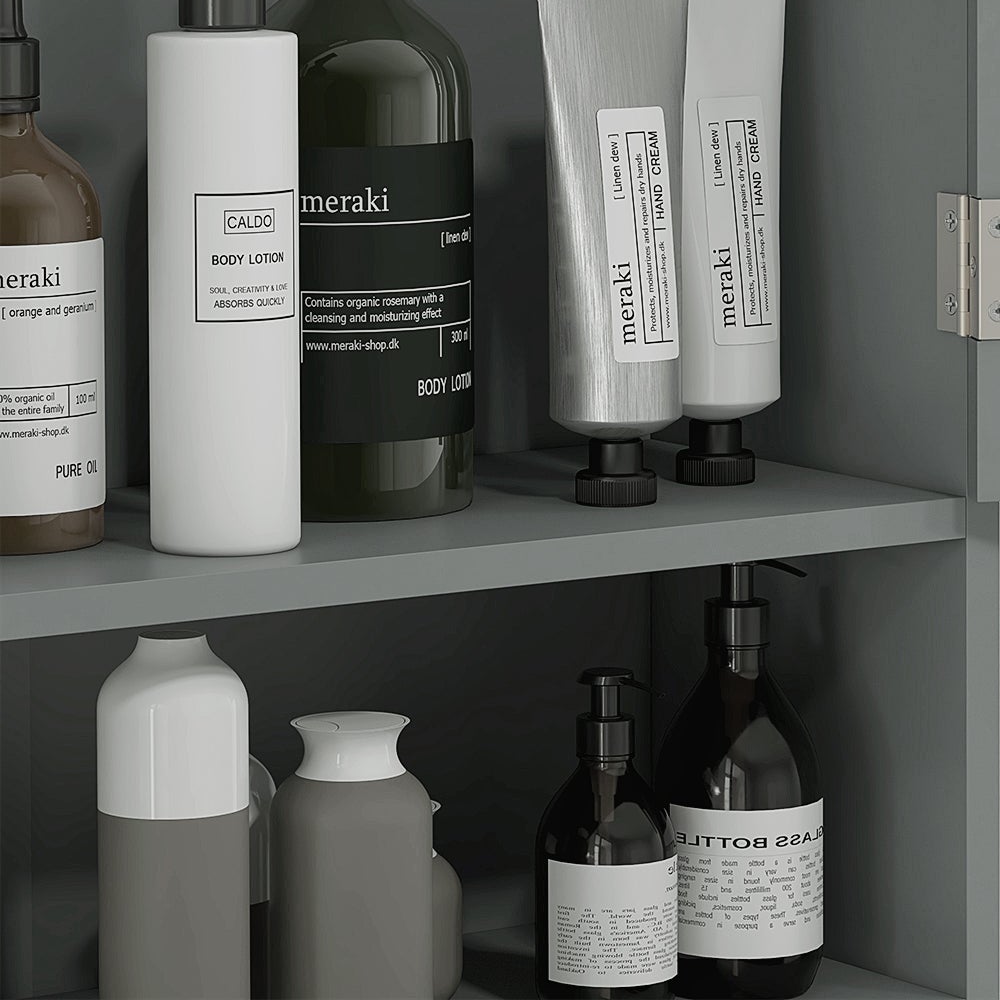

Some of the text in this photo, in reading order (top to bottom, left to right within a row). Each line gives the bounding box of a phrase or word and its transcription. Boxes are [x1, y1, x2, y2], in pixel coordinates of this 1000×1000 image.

[711, 130, 720, 150] dew
[610, 142, 620, 163] dew
[735, 141, 743, 166] hands
[635, 153, 644, 179] hands
[713, 153, 723, 180] Linen
[747, 120, 764, 206] HAND CREAM
[613, 165, 622, 193] Linen
[648, 131, 665, 220] HAND CREAM
[738, 168, 746, 182] dry
[638, 181, 646, 195] dry
[300, 187, 390, 214] meraki
[740, 184, 748, 212] repairs
[640, 197, 649, 226] repairs
[228, 215, 272, 229] CALDO
[741, 214, 749, 229] and
[642, 228, 650, 244] and
[212, 252, 284, 265] BODY LOTION
[744, 231, 754, 277] moisturizes
[0, 267, 61, 289] eraki
[645, 246, 654, 293] moisturizes
[210, 287, 230, 295] SOUL,
[233, 285, 270, 294] CREATIVITY
[276, 283, 288, 291] LOVE
[713, 247, 737, 328] meraki
[214, 297, 285, 308] ABSORBS QUICKLY
[305, 296, 344, 308] Contains
[346, 296, 380, 310] organic
[383, 295, 420, 308] rosemary
[422, 293, 438, 303] with
[612, 262, 637, 345] meraki
[9, 308, 43, 319] orange
[46, 305, 61, 316] and
[305, 307, 442, 325] cleansing and moisturizing effect
[306, 338, 400, 352] www.meraki-shop.dk
[451, 330, 463, 343] 300
[418, 377, 447, 396] BODY
[15, 393, 44, 404] organic
[46, 392, 55, 401] oil
[76, 394, 87, 405] 100
[2, 404, 65, 416] the entire family
[56, 460, 97, 479] PURE OIL
